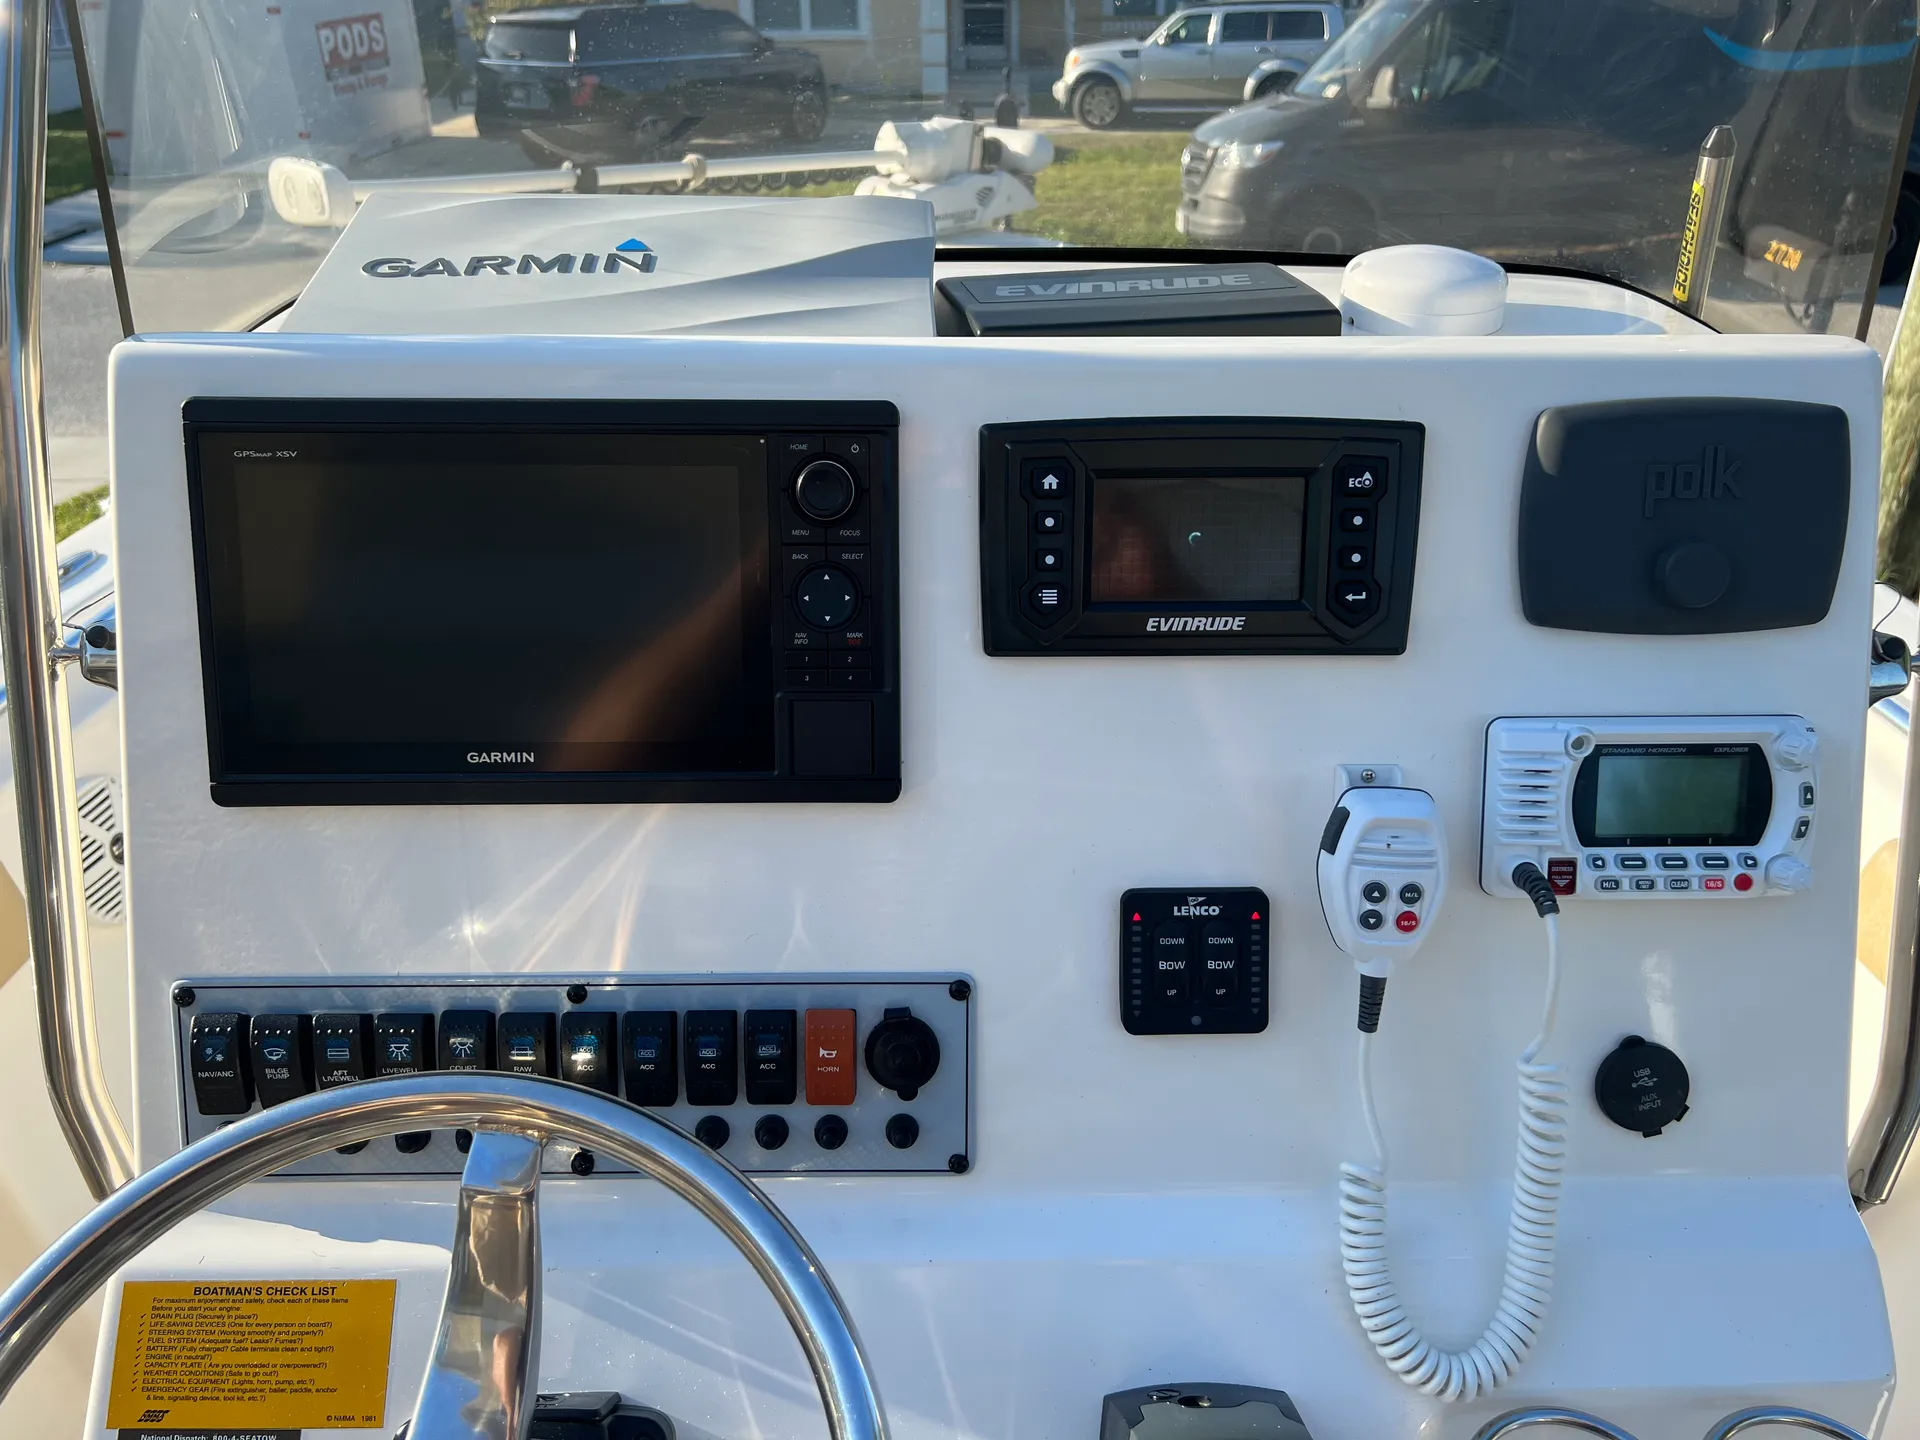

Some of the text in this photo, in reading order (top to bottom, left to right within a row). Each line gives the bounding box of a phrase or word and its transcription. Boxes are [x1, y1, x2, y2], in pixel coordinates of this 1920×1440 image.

[318, 20, 385, 63] PODS
[1674, 190, 1701, 295] SEACHOICE
[361, 251, 658, 278] GARMIN
[995, 274, 1251, 297] EVINRUDE
[275, 450, 298, 458] XSV
[1348, 473, 1373, 488] ECO
[1644, 444, 1743, 519] polk
[791, 529, 810, 537] MENU
[839, 529, 861, 537] FOCUS
[1145, 616, 1246, 632] EVINRUDE
[466, 752, 535, 763] GARMIN
[1159, 937, 1185, 945] DOWN
[1158, 960, 1186, 970] BOW
[1207, 960, 1235, 969] BOW
[198, 1070, 235, 1078] NAV/ANC
[1633, 1067, 1651, 1078] USB
[1640, 1092, 1658, 1103] AUX
[1639, 1099, 1661, 1111] INPUT
[193, 1286, 337, 1296] BOATMAN'S CHECK LIST
